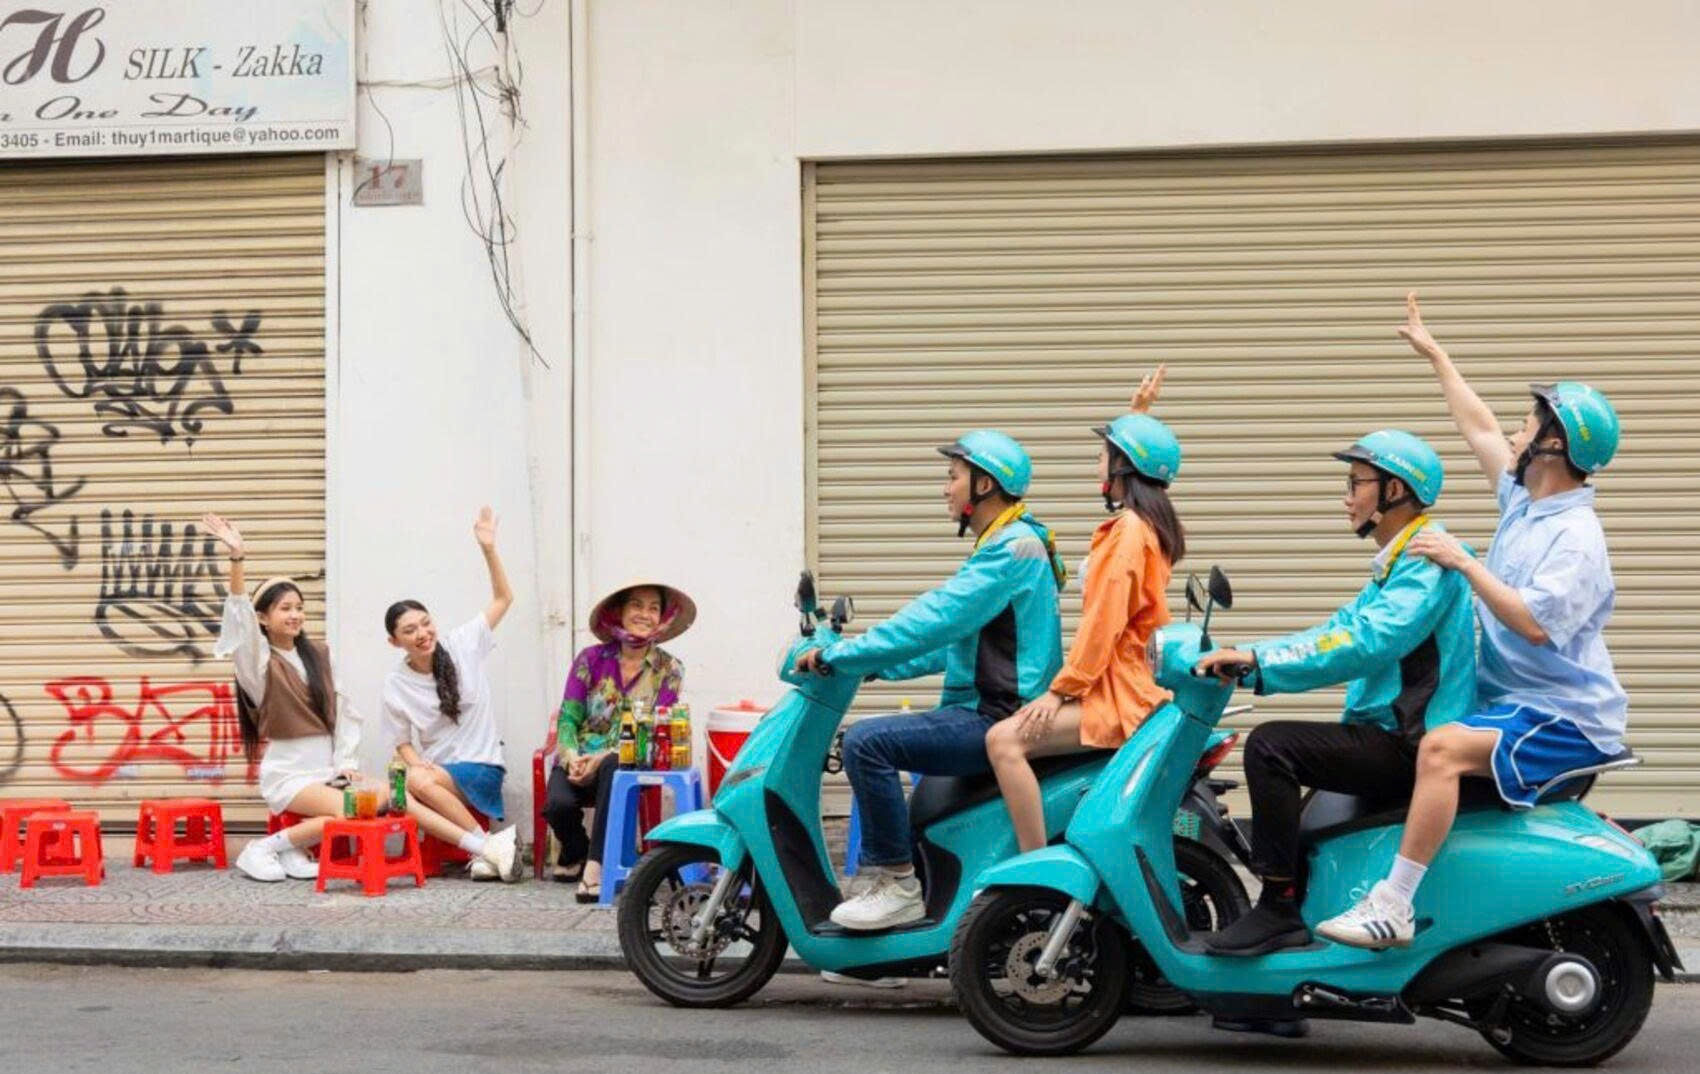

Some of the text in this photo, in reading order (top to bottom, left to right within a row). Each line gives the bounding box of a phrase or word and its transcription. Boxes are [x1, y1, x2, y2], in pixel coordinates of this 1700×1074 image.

[123, 47, 208, 81] SILK
[232, 44, 324, 77] Zakka
[35, 93, 258, 122] One Day
[54, 130, 106, 147] Email:
[112, 127, 339, 147] thuy1martique@yahoo.com
[366, 165, 409, 190] 17
